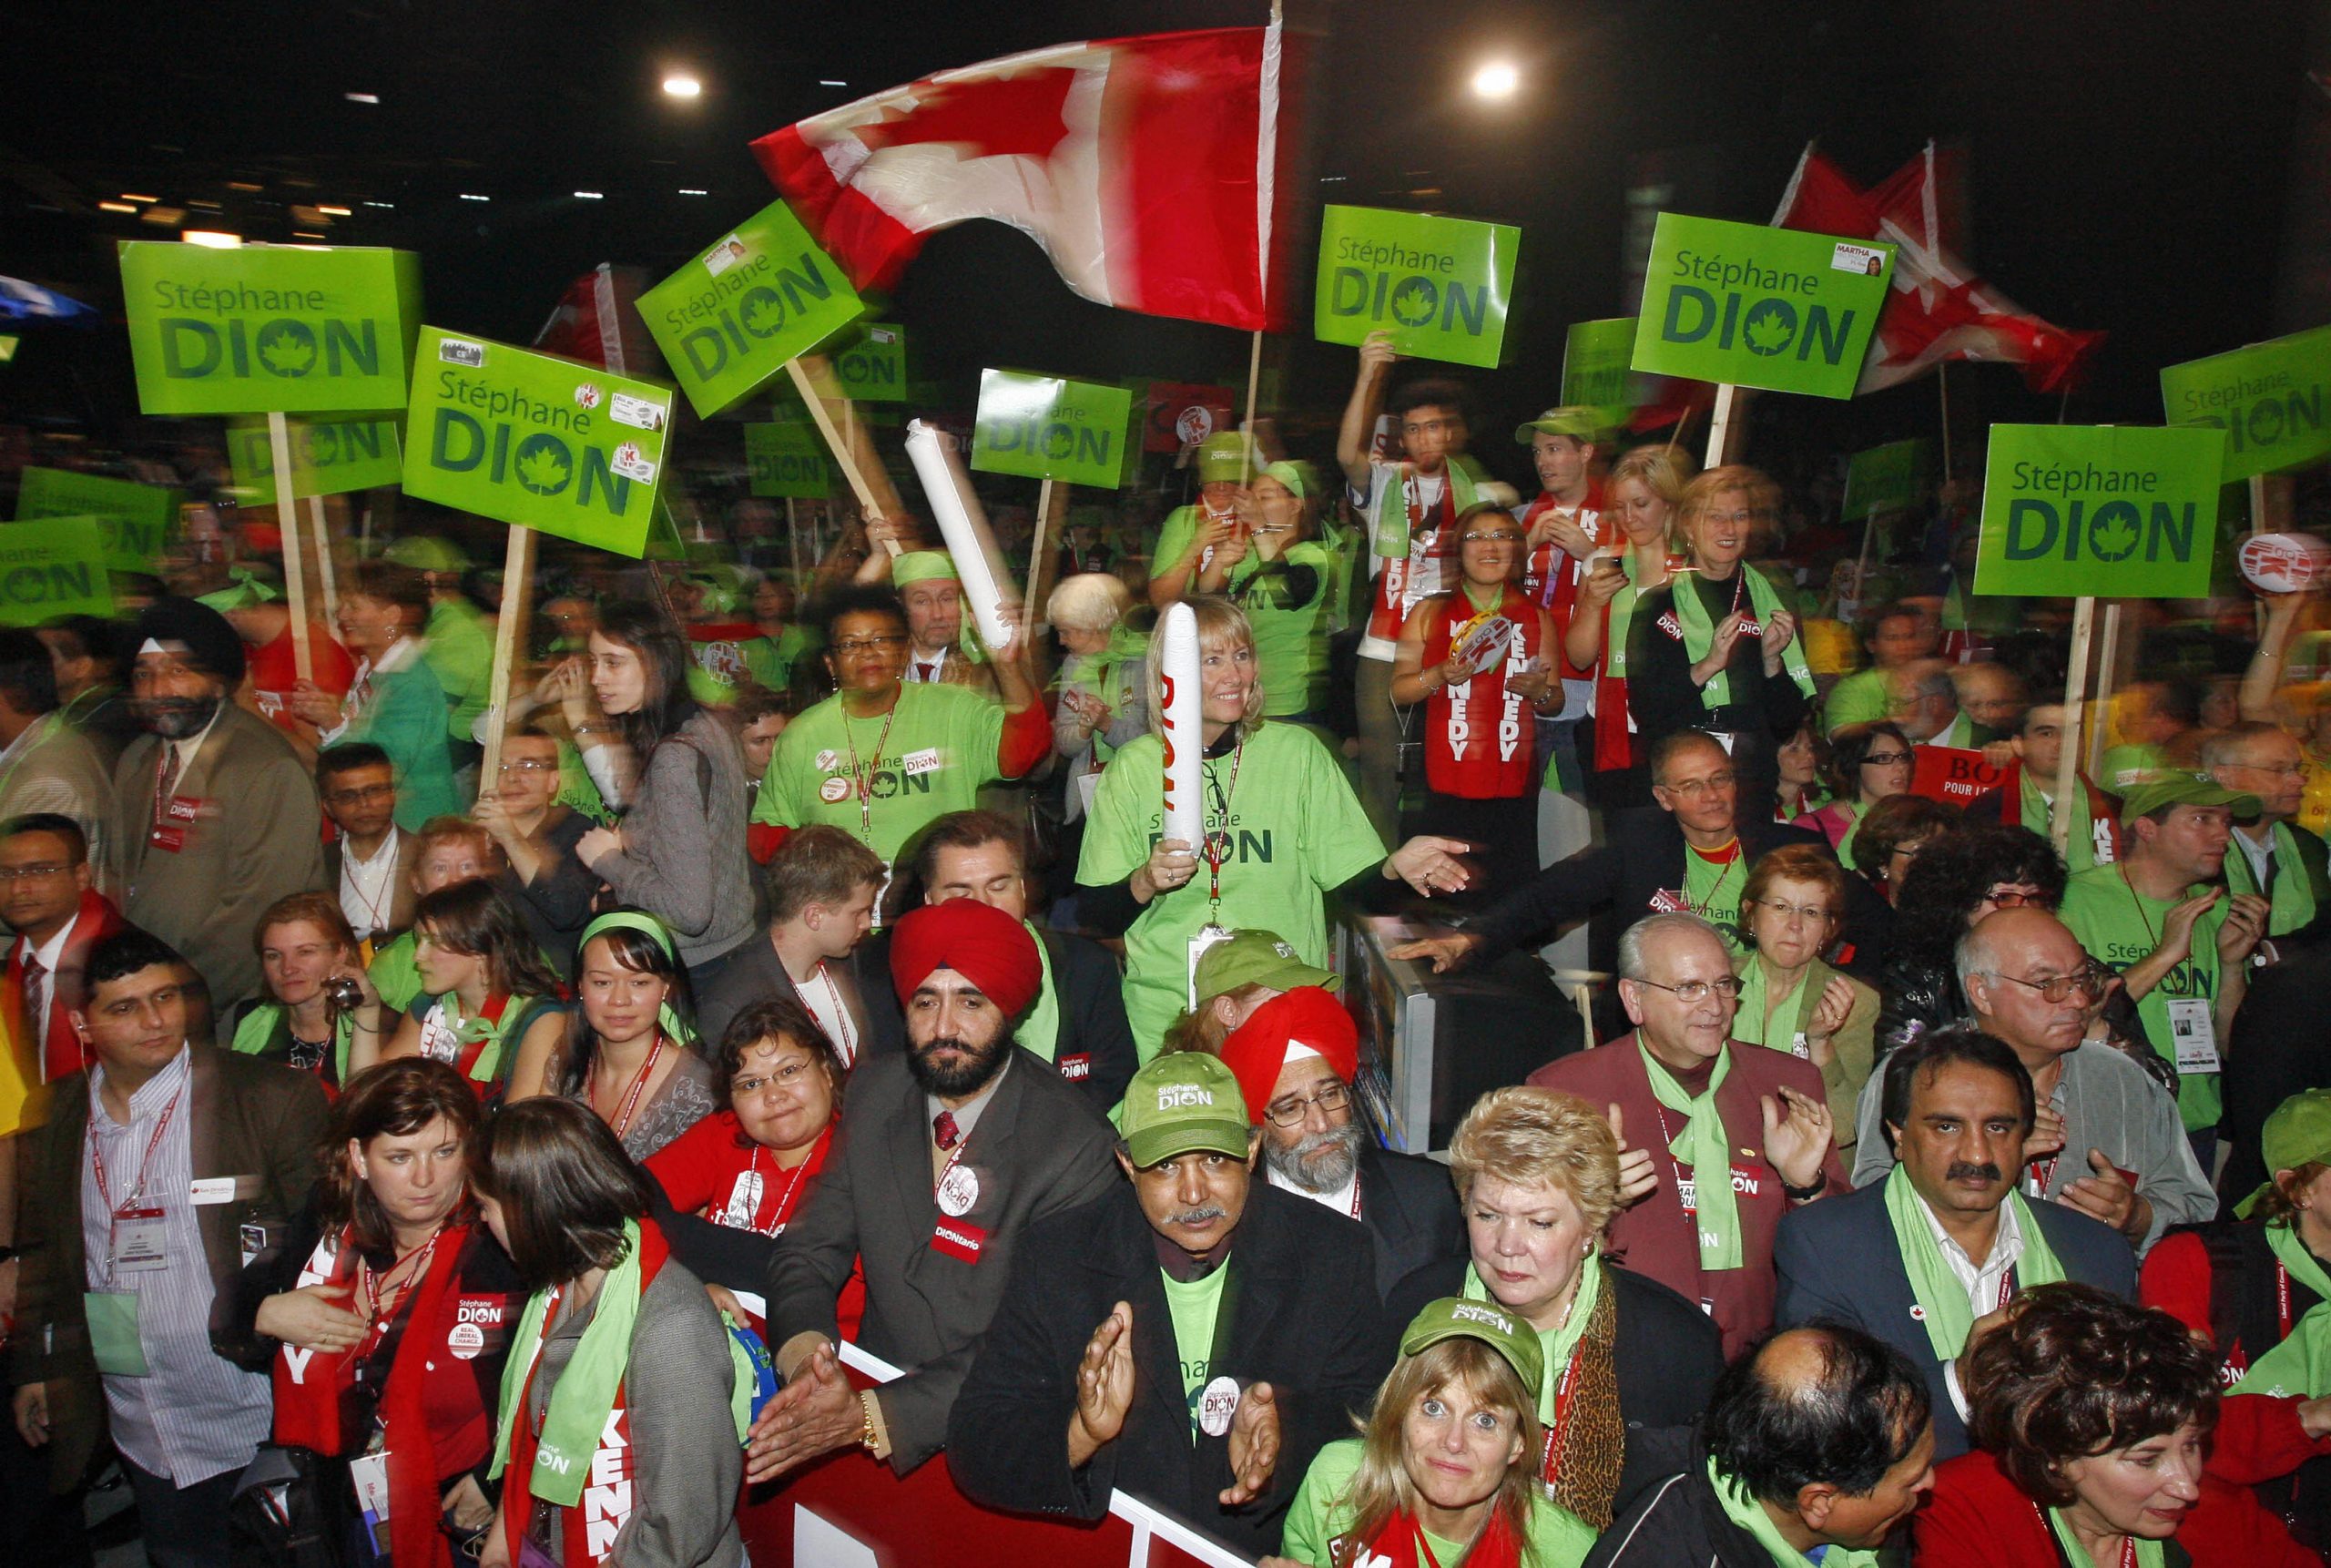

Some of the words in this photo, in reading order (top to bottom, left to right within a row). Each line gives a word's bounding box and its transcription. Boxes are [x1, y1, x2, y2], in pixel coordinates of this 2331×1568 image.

[1337, 237, 1454, 273] Stéphane
[1836, 245, 1869, 256] MARTHA
[1674, 250, 1818, 295] Stéphane
[154, 280, 325, 318] Stéphane
[666, 254, 770, 333] Stéphane
[1330, 267, 1488, 337] DION
[680, 252, 832, 383] DION
[1661, 284, 1855, 365] DION
[159, 318, 380, 379] DION
[437, 371, 591, 434] Stéphane
[2185, 370, 2290, 412] Stéphane
[989, 419, 1111, 465] DION
[431, 407, 631, 517] DION
[2012, 461, 2157, 498] Stéphane
[2003, 499, 2196, 563] DION
[1656, 616, 1684, 639] DION
[1738, 622, 1764, 636] DIO
[906, 756, 938, 772] DION
[1944, 781, 1972, 797] POUR
[170, 805, 196, 819] DION
[1062, 1063, 1089, 1078] DION
[1159, 1090, 1213, 1111] DION
[935, 1227, 980, 1250] DIONtario
[457, 1307, 502, 1323] DION
[459, 1299, 493, 1308] Stéphane
[1451, 1310, 1513, 1336] DION
[1206, 1397, 1236, 1412] DION
